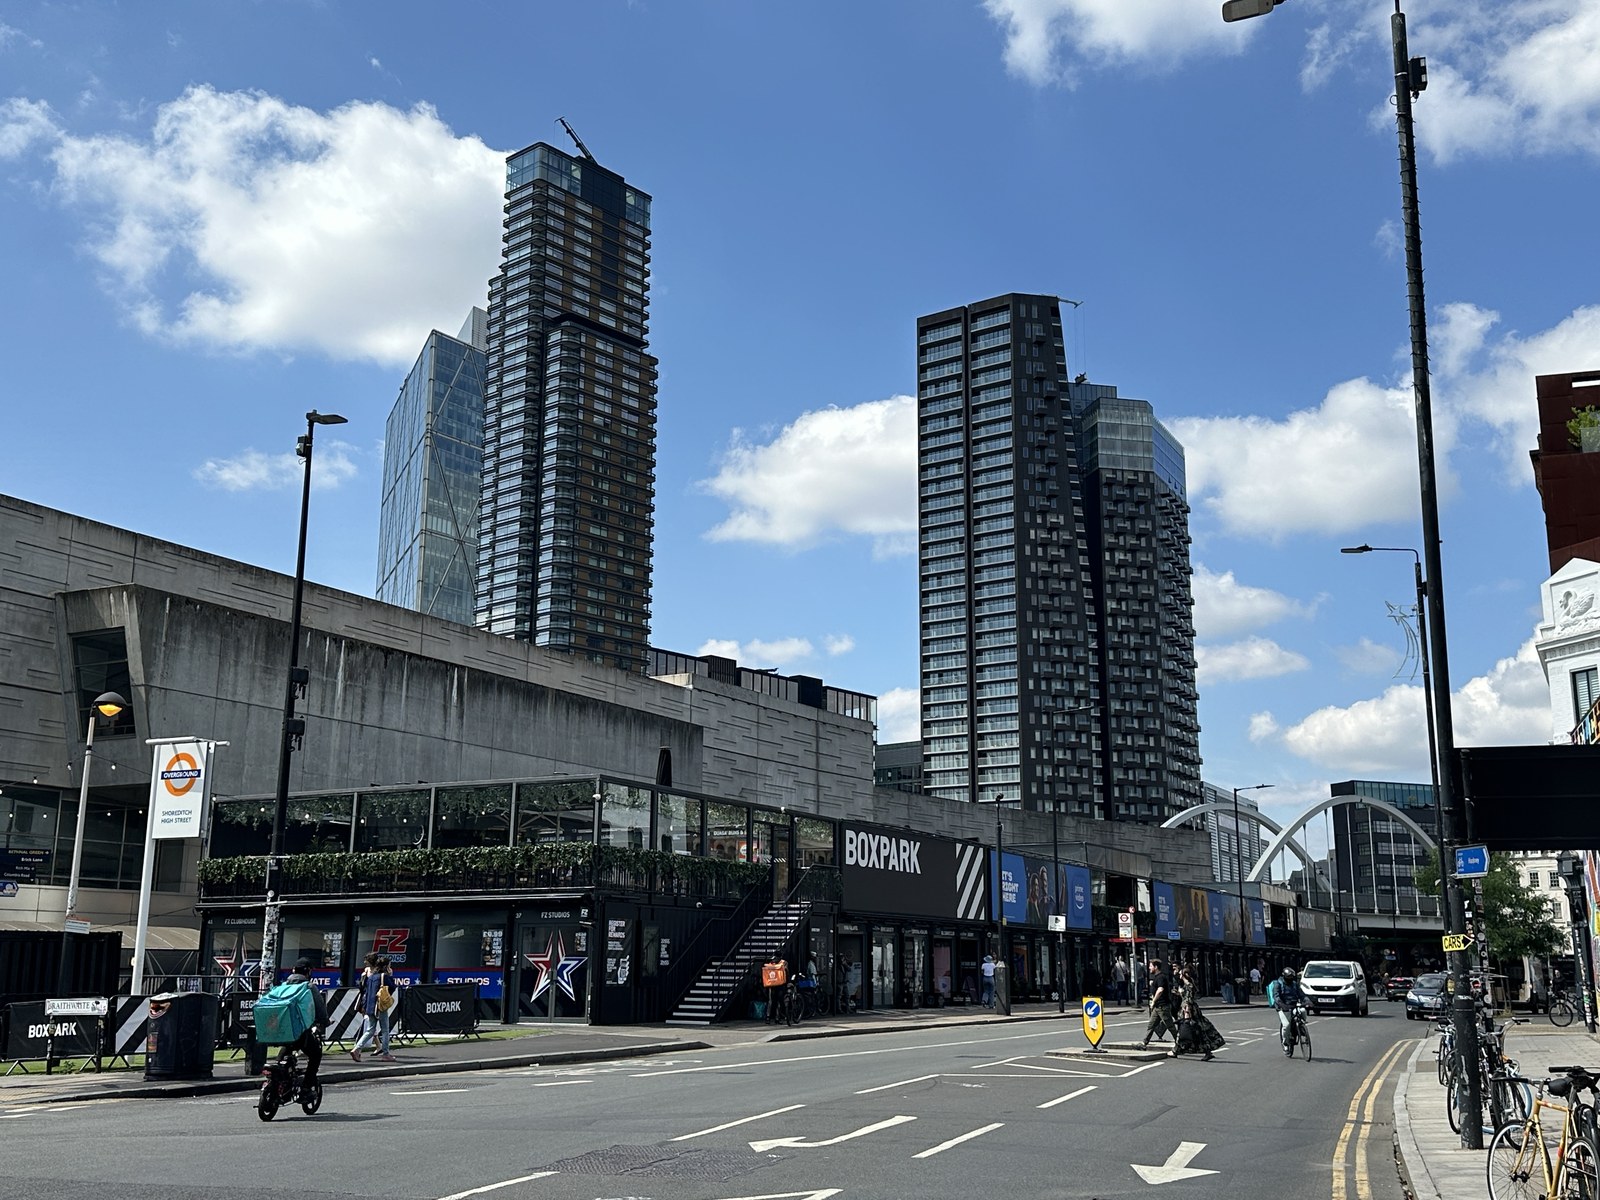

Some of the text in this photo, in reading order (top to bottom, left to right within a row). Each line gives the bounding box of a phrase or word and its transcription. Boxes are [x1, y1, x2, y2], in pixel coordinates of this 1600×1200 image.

[163, 770, 199, 779] OVERGROUND
[845, 829, 921, 875] BOXPARK
[541, 911, 548, 919] FZ
[372, 928, 410, 953] FZ
[1444, 935, 1462, 949] CARS
[425, 1000, 461, 1014] BOXPARK
[28, 1022, 77, 1038] BOXARK
